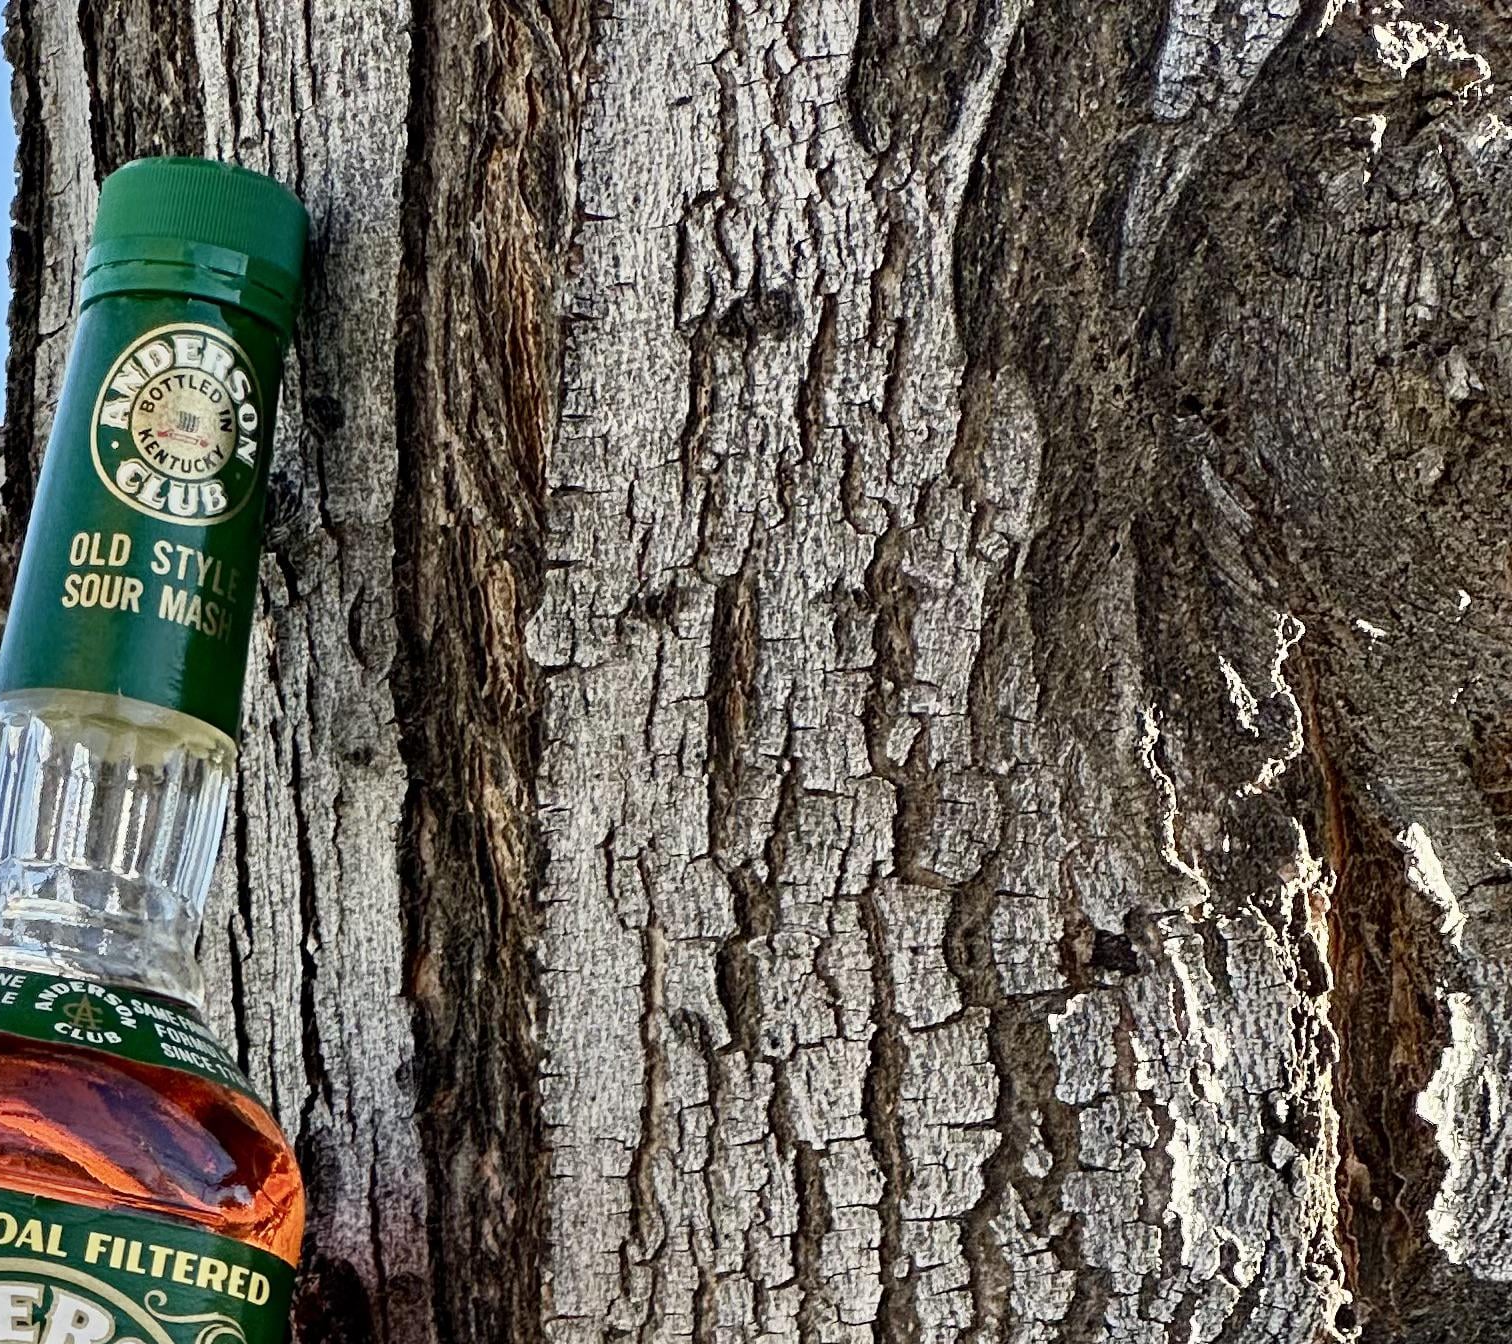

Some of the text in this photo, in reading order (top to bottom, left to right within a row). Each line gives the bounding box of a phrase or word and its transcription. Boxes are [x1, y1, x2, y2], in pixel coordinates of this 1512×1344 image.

[100, 334, 259, 469] ANDERSON
[140, 374, 233, 433] BOTTLED IN
[138, 428, 225, 473] KENTUCKY
[116, 458, 228, 517] CLUB
[69, 532, 240, 603] OLD STYLE
[61, 573, 233, 644] SOUR MASH
[34, 980, 137, 1030] ANDERSON
[54, 1022, 123, 1045] CLUB
[130, 999, 180, 1027] SAME
[160, 1042, 217, 1074] SINCE
[84, 1231, 271, 1306] FILTERED
